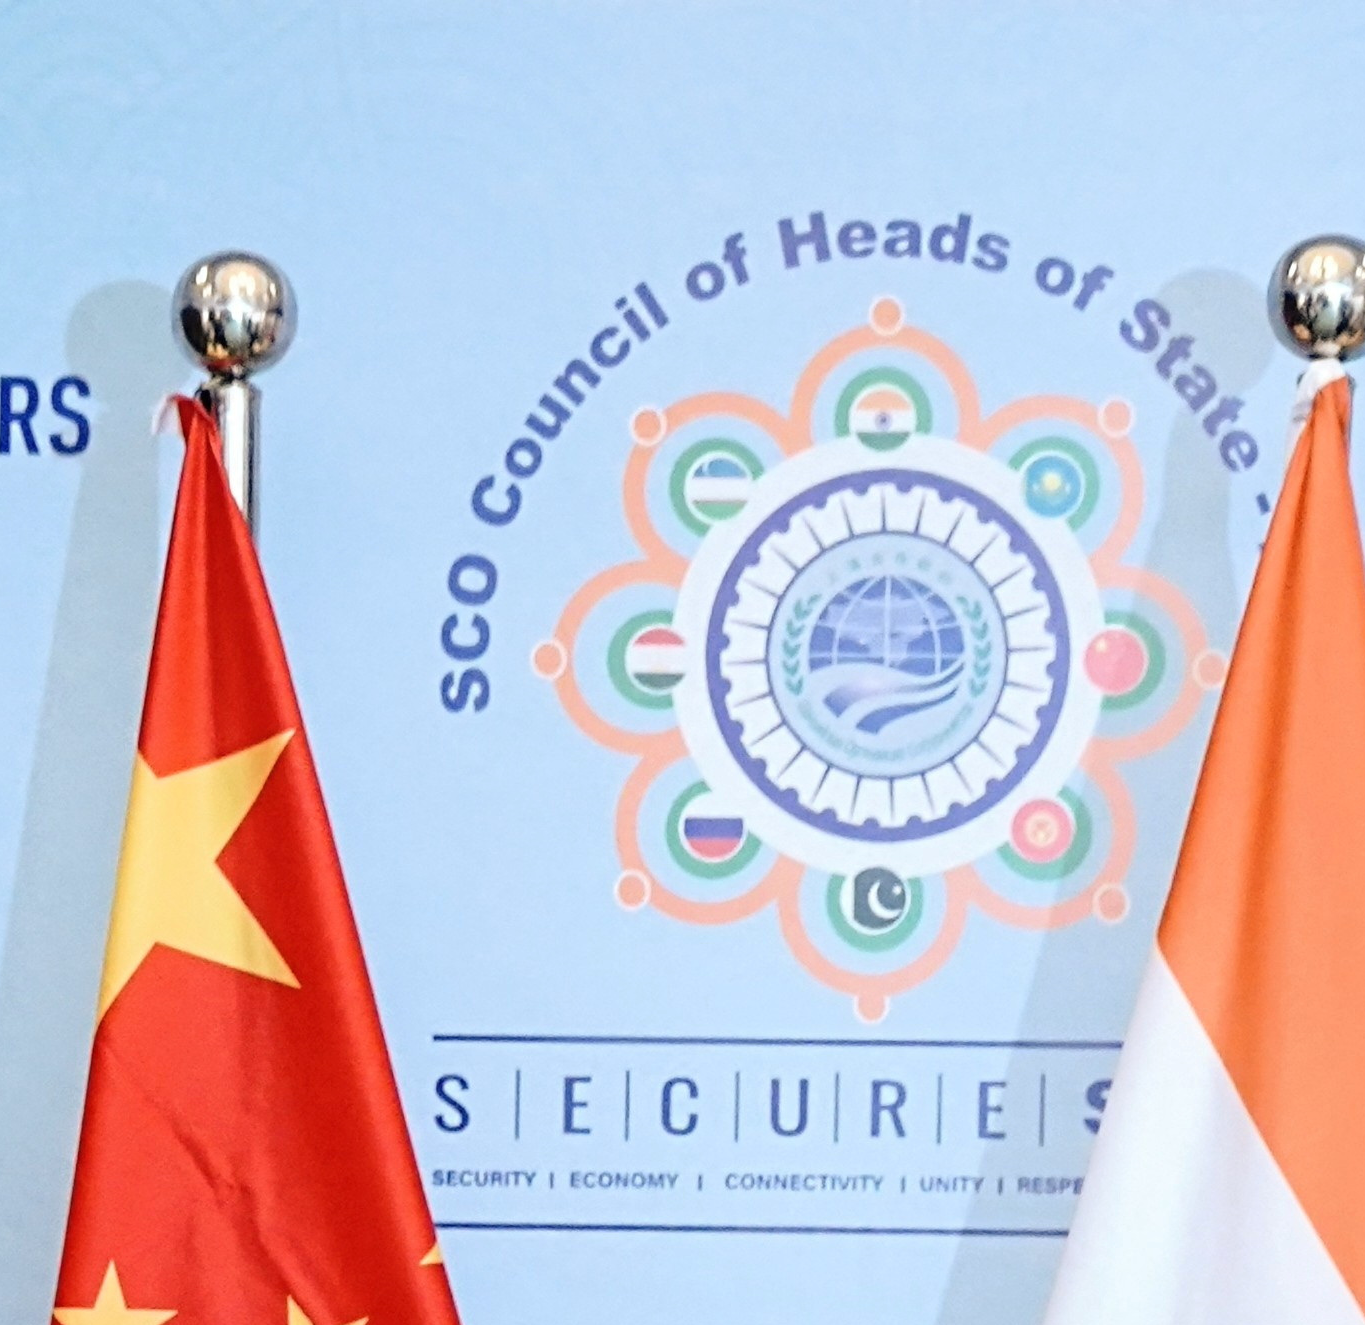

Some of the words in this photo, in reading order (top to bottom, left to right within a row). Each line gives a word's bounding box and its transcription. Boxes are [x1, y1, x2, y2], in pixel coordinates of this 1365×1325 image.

[440, 553, 499, 713] SCO
[470, 281, 670, 527] Council
[685, 231, 750, 301] of
[776, 210, 1011, 271] Heads
[1035, 256, 1115, 312] of
[1119, 298, 1260, 473] State
[432, 1169, 537, 1187] SECURITY
[569, 1171, 679, 1189] ECONOMY
[724, 1172, 883, 1191] CONNECTIVITY
[919, 1175, 985, 1194] UNITY
[1017, 1176, 1084, 1195] RESPE
